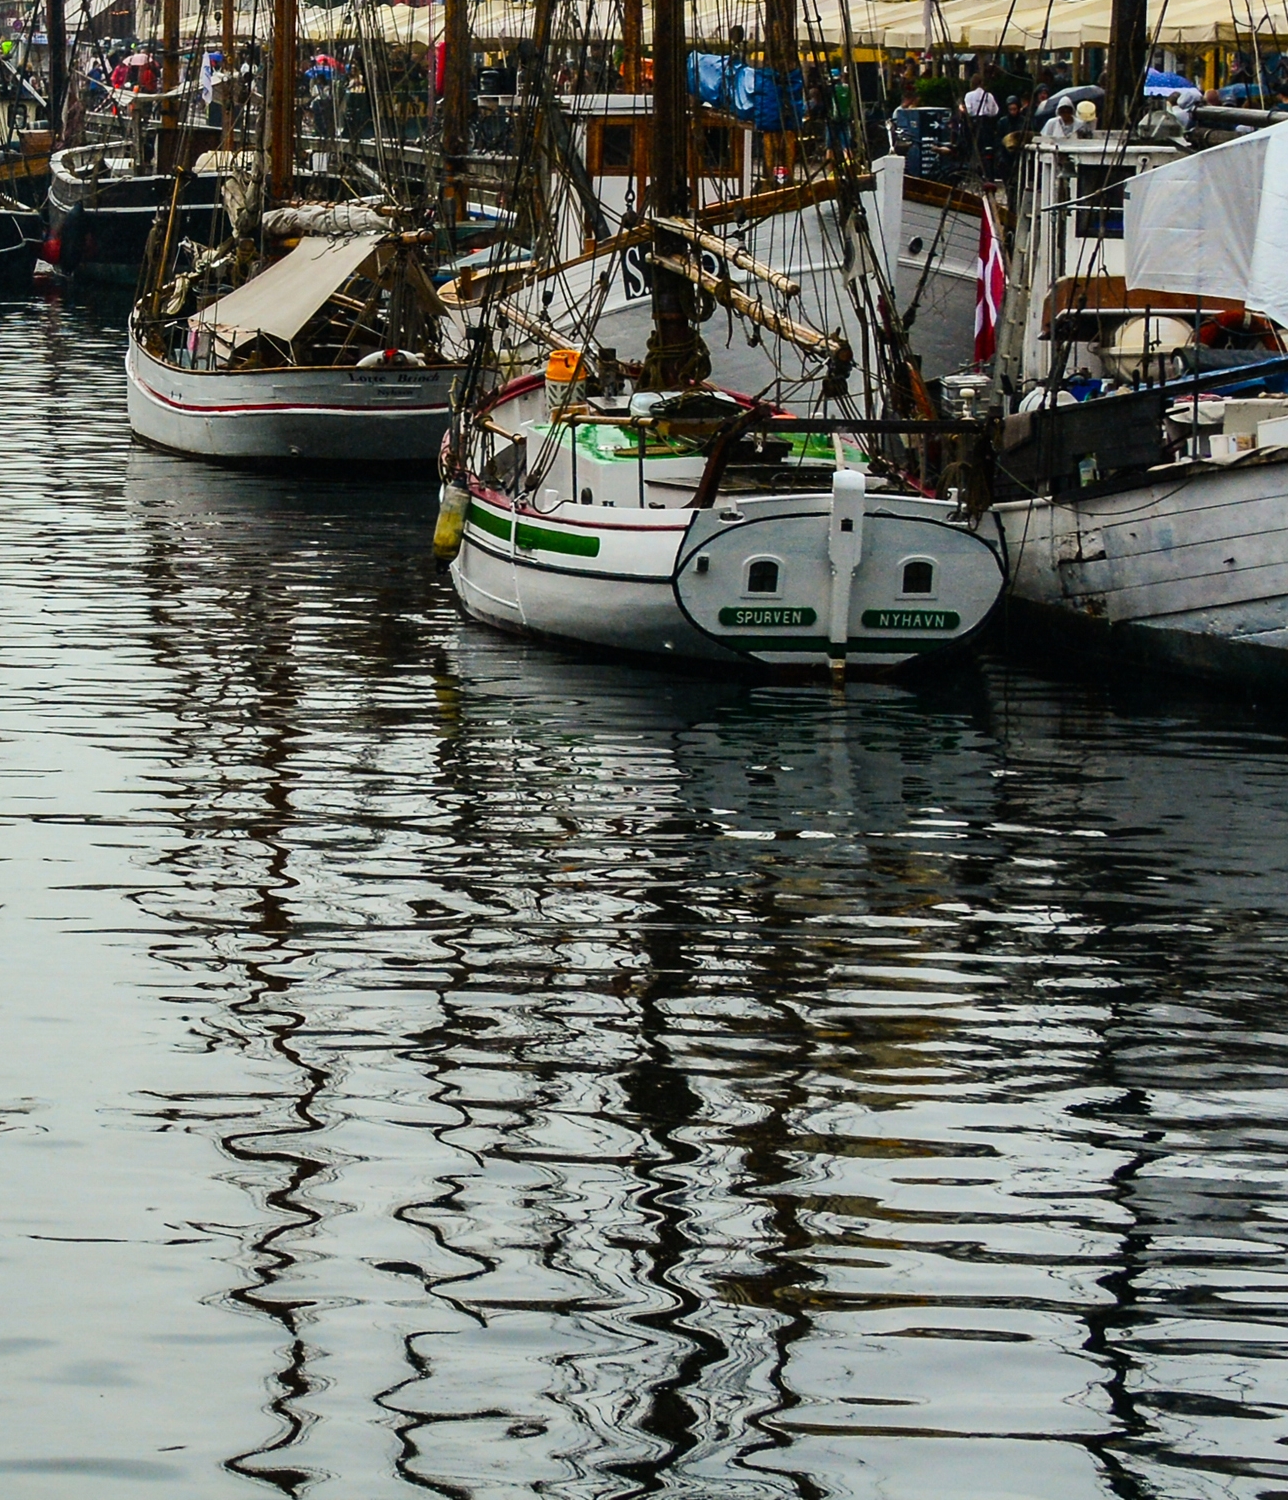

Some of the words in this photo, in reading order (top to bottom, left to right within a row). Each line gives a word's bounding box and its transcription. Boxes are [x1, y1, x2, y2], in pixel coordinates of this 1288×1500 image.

[348, 372, 387, 384] Lotte
[397, 372, 440, 383] Brinch
[736, 610, 802, 624] SPURVEN
[879, 613, 945, 628] NYHAVN
